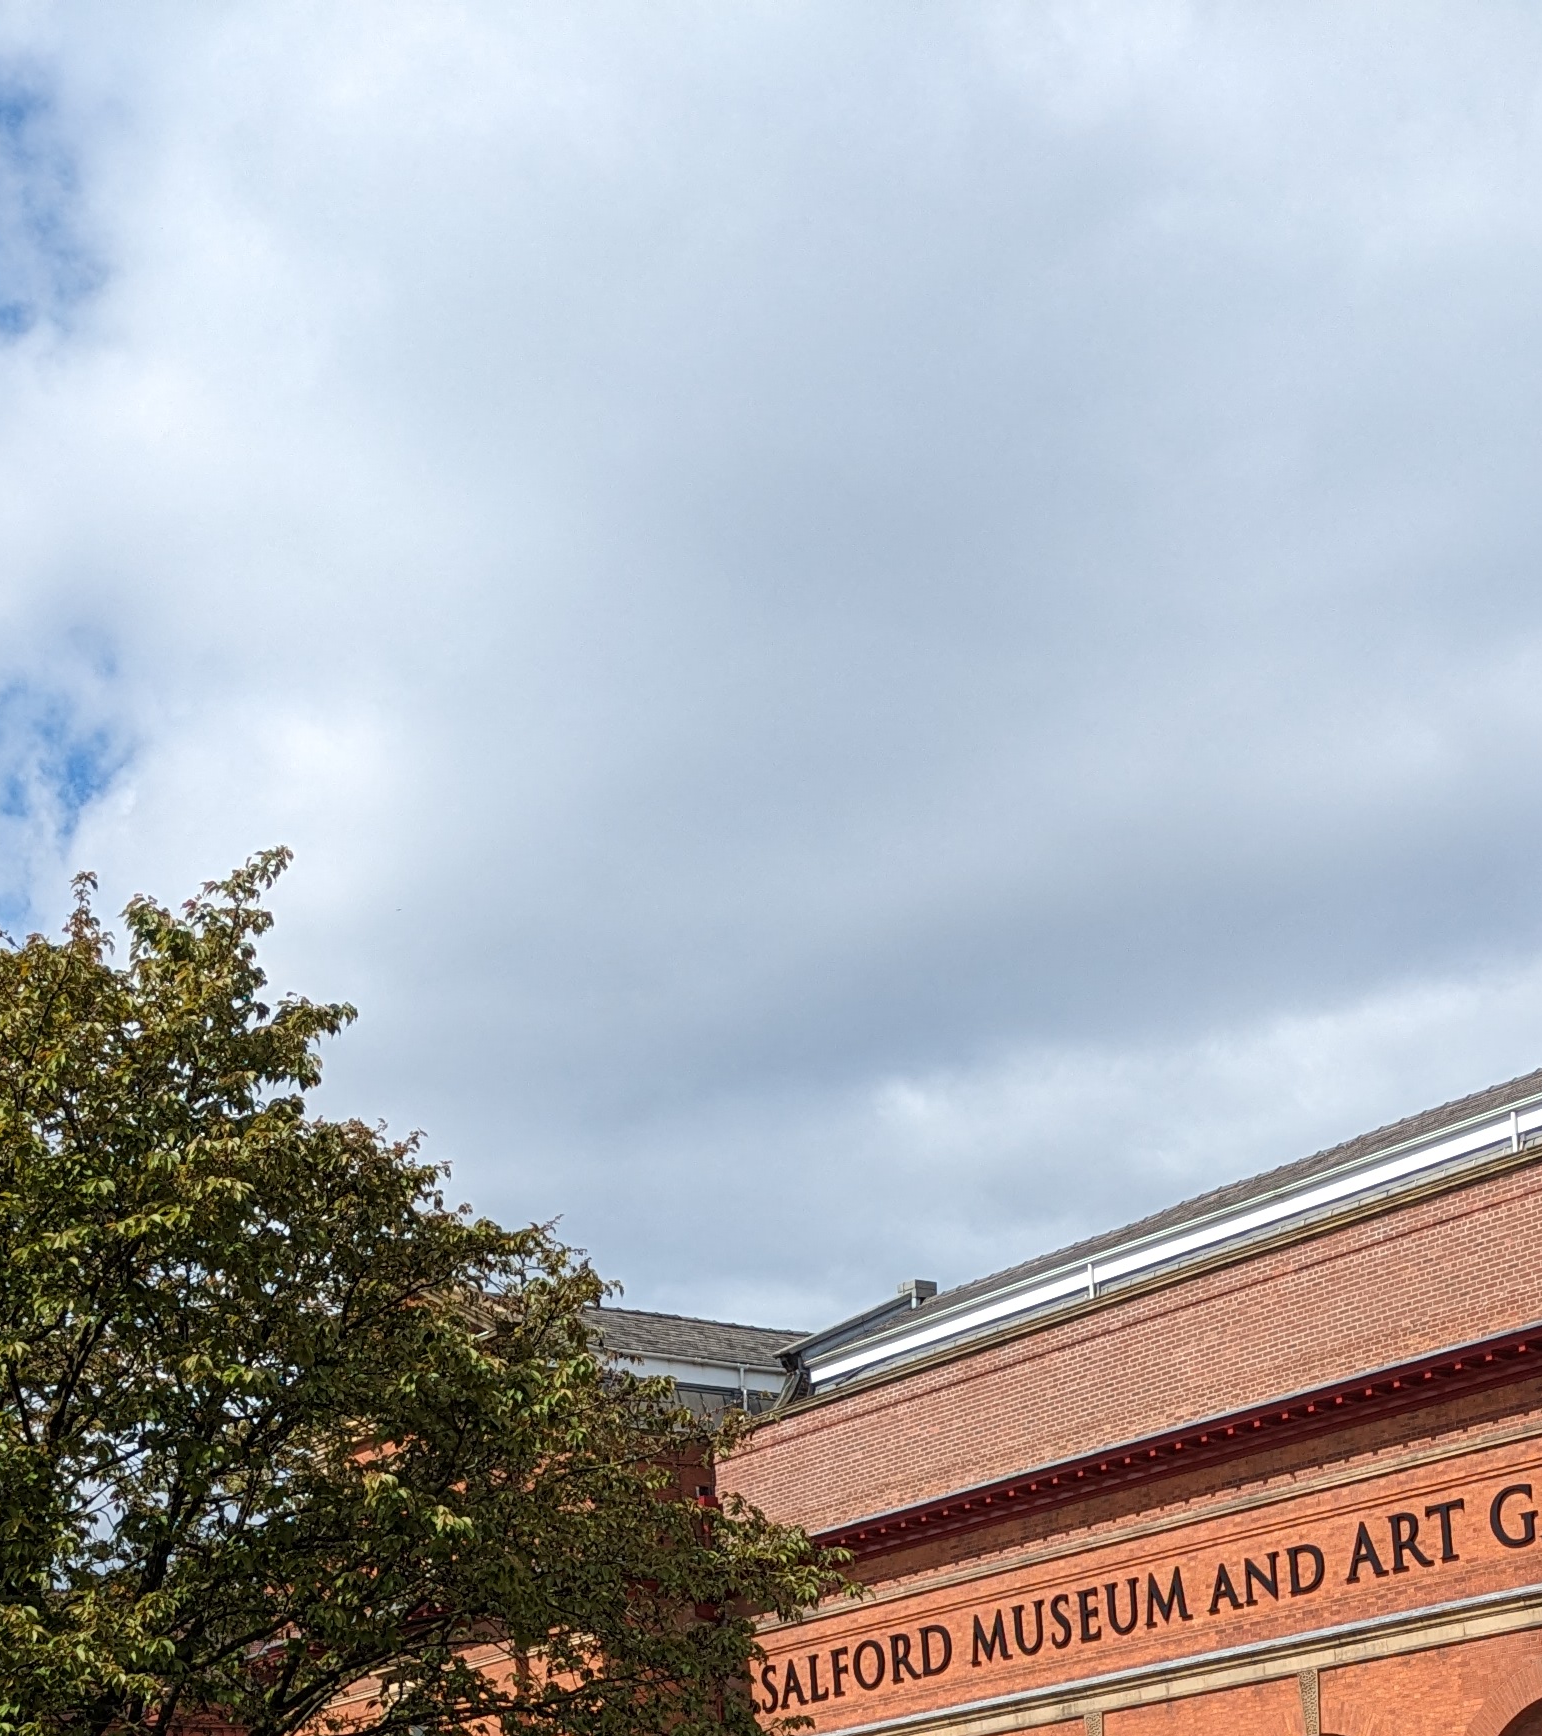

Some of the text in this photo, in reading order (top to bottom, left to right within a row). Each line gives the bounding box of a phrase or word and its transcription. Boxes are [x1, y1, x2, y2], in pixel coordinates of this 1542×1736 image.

[760, 1623, 953, 1715] SALFORD
[971, 1565, 1194, 1667] MUSEUM
[1208, 1543, 1326, 1614] AND
[1347, 1497, 1466, 1584] ART
